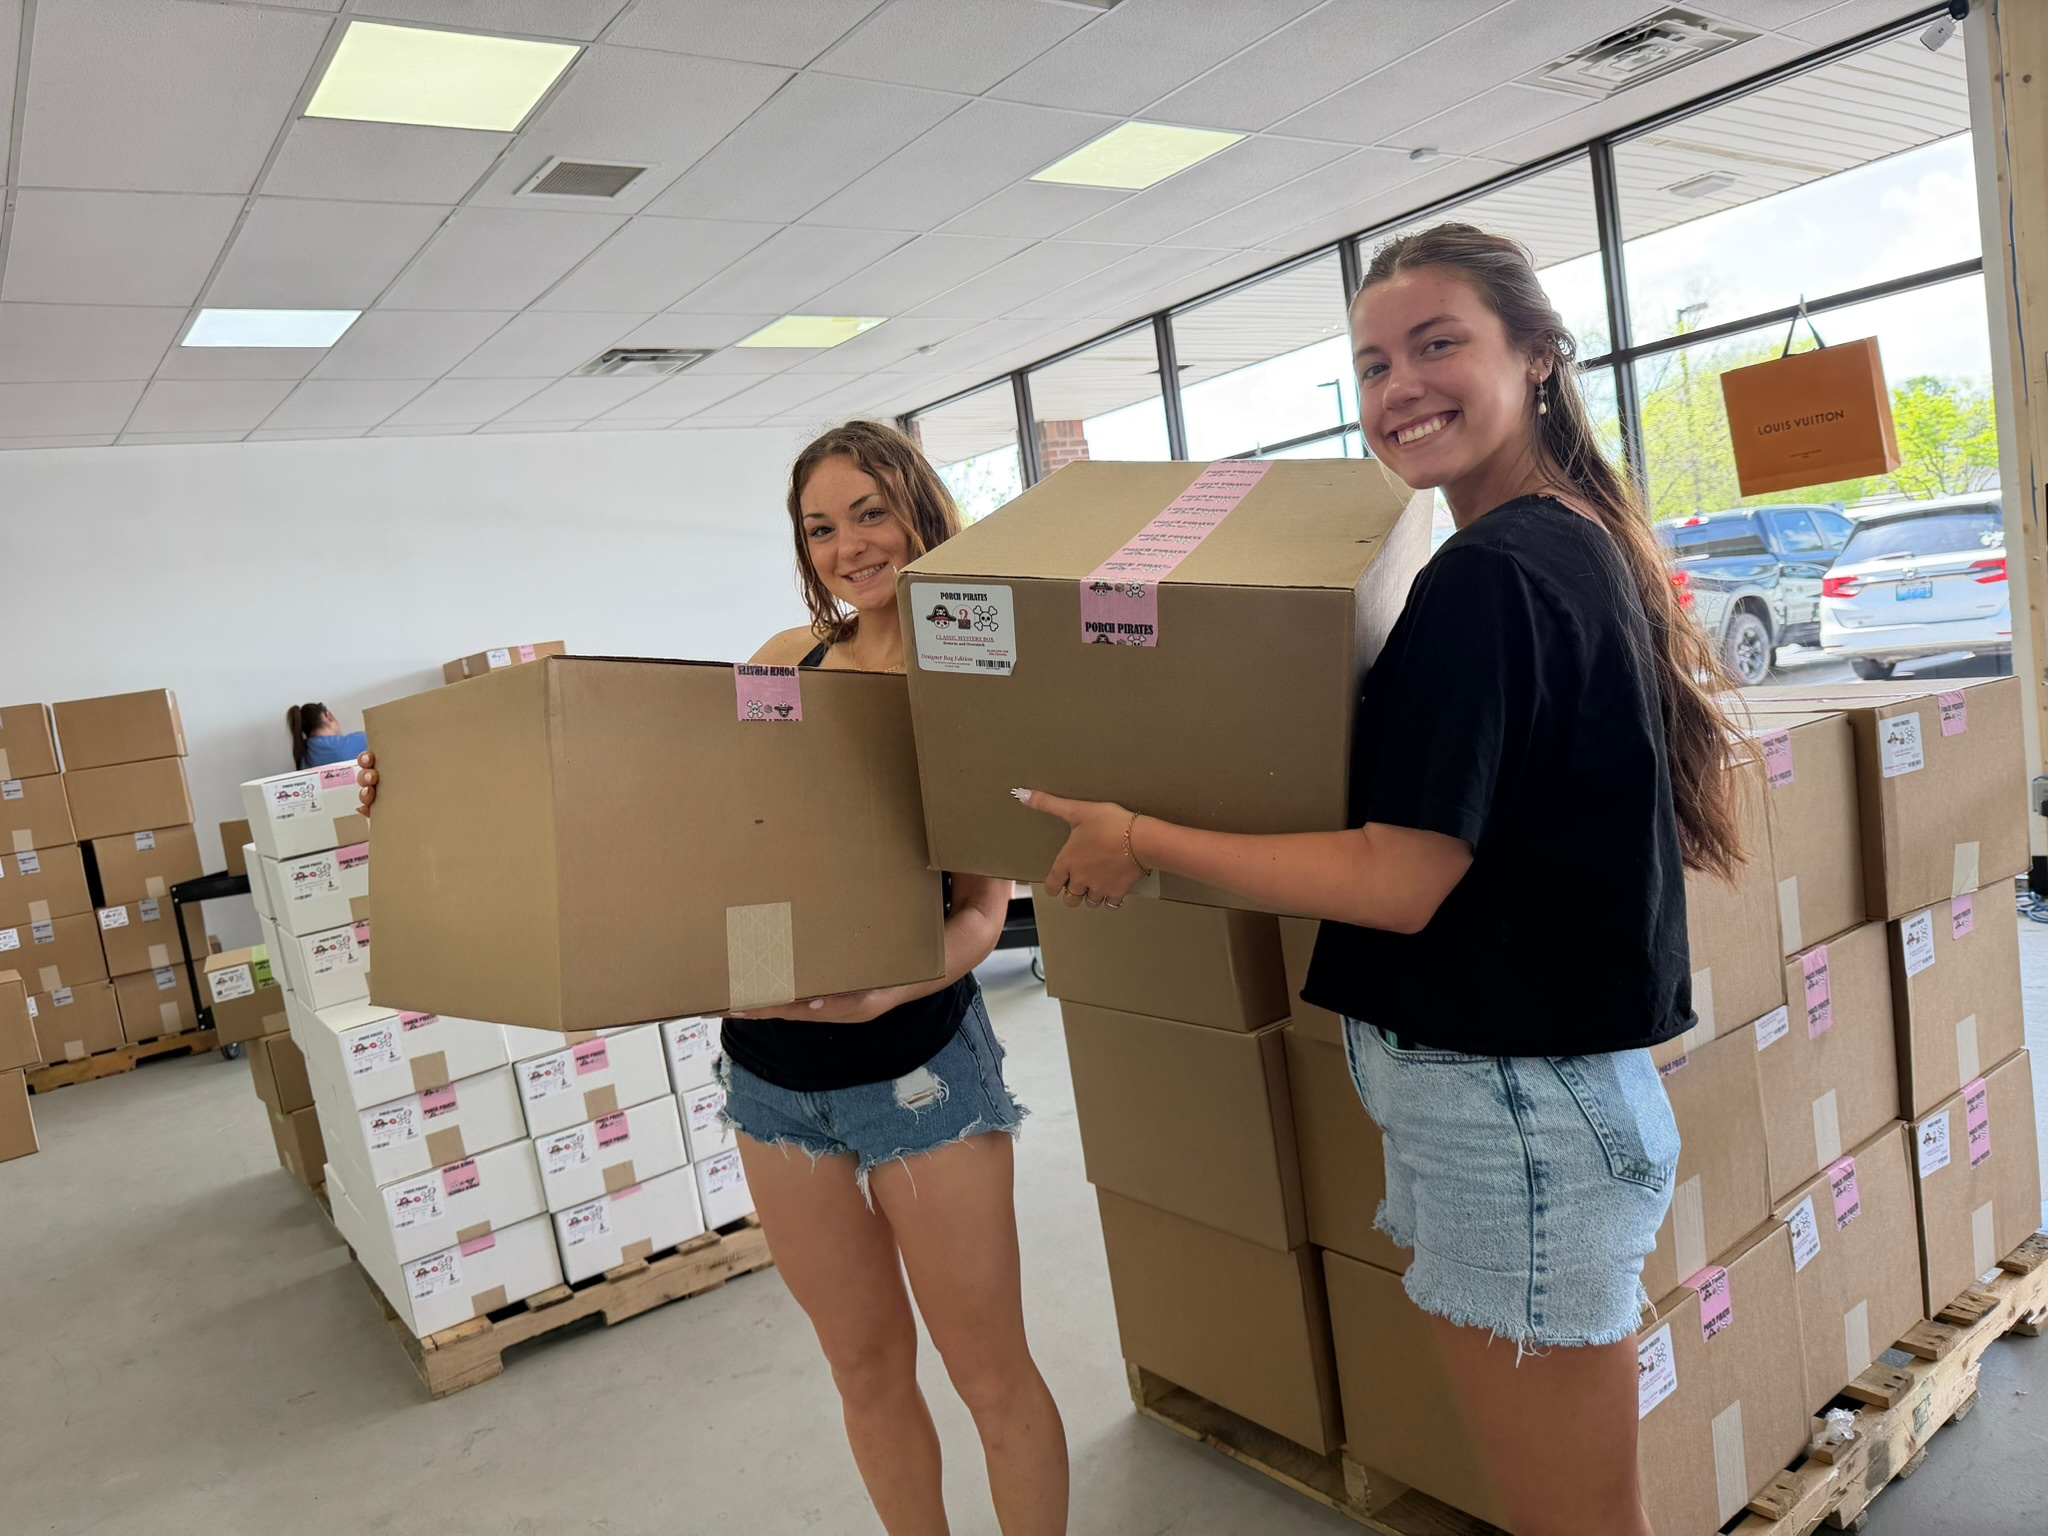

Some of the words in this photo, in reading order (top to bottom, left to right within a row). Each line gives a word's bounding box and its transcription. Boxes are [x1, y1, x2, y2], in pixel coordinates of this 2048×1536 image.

[1758, 420, 1791, 435] LOUIS
[1794, 409, 1844, 428] VUITTON
[940, 592, 961, 600] PORCH
[963, 593, 988, 601] PIRATES
[1085, 622, 1115, 633] PORCH
[1118, 623, 1153, 635] PIRATES
[738, 666, 768, 676] PIRATES
[770, 667, 795, 676] PORCH
